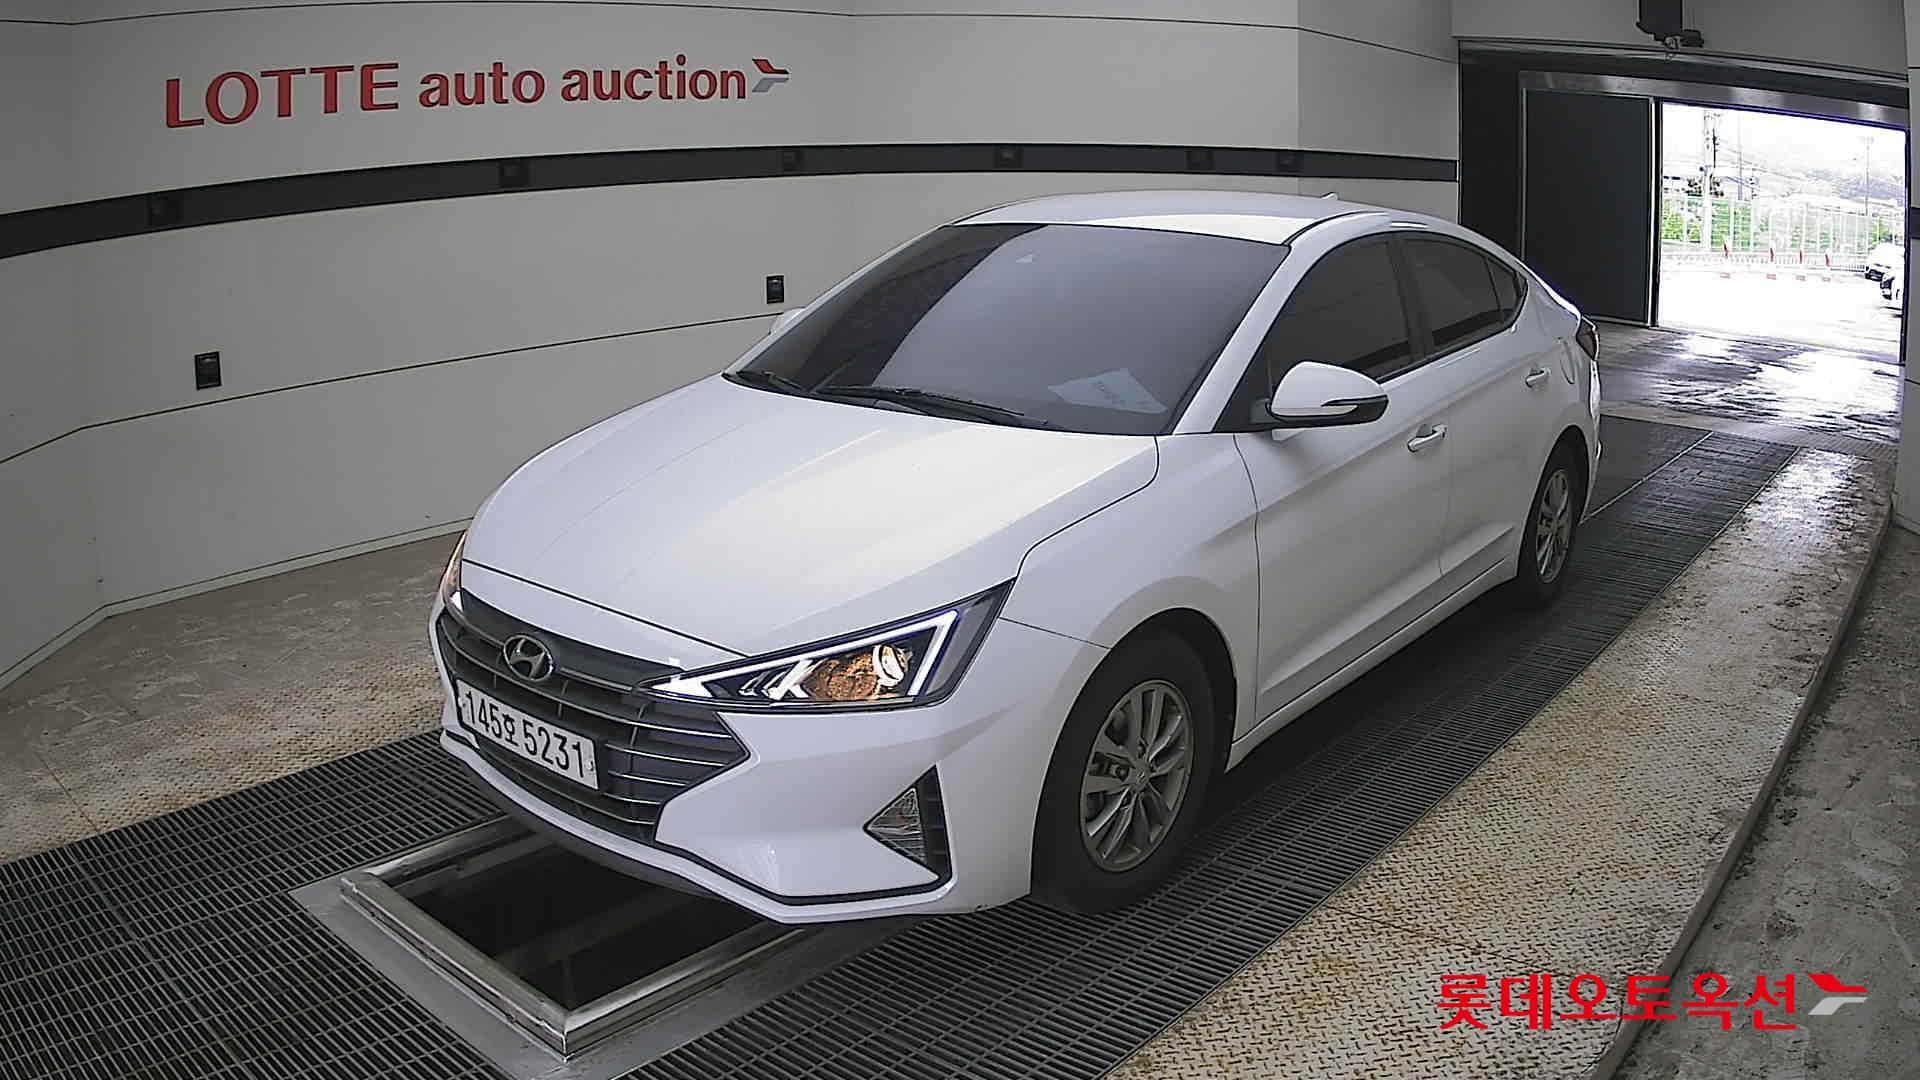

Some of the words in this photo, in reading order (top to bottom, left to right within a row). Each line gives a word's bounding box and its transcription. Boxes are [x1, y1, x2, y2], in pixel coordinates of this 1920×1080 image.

[166, 63, 399, 127] LOTTE
[419, 62, 545, 107] auto
[561, 55, 747, 102] auction
[522, 719, 584, 778] 5231
